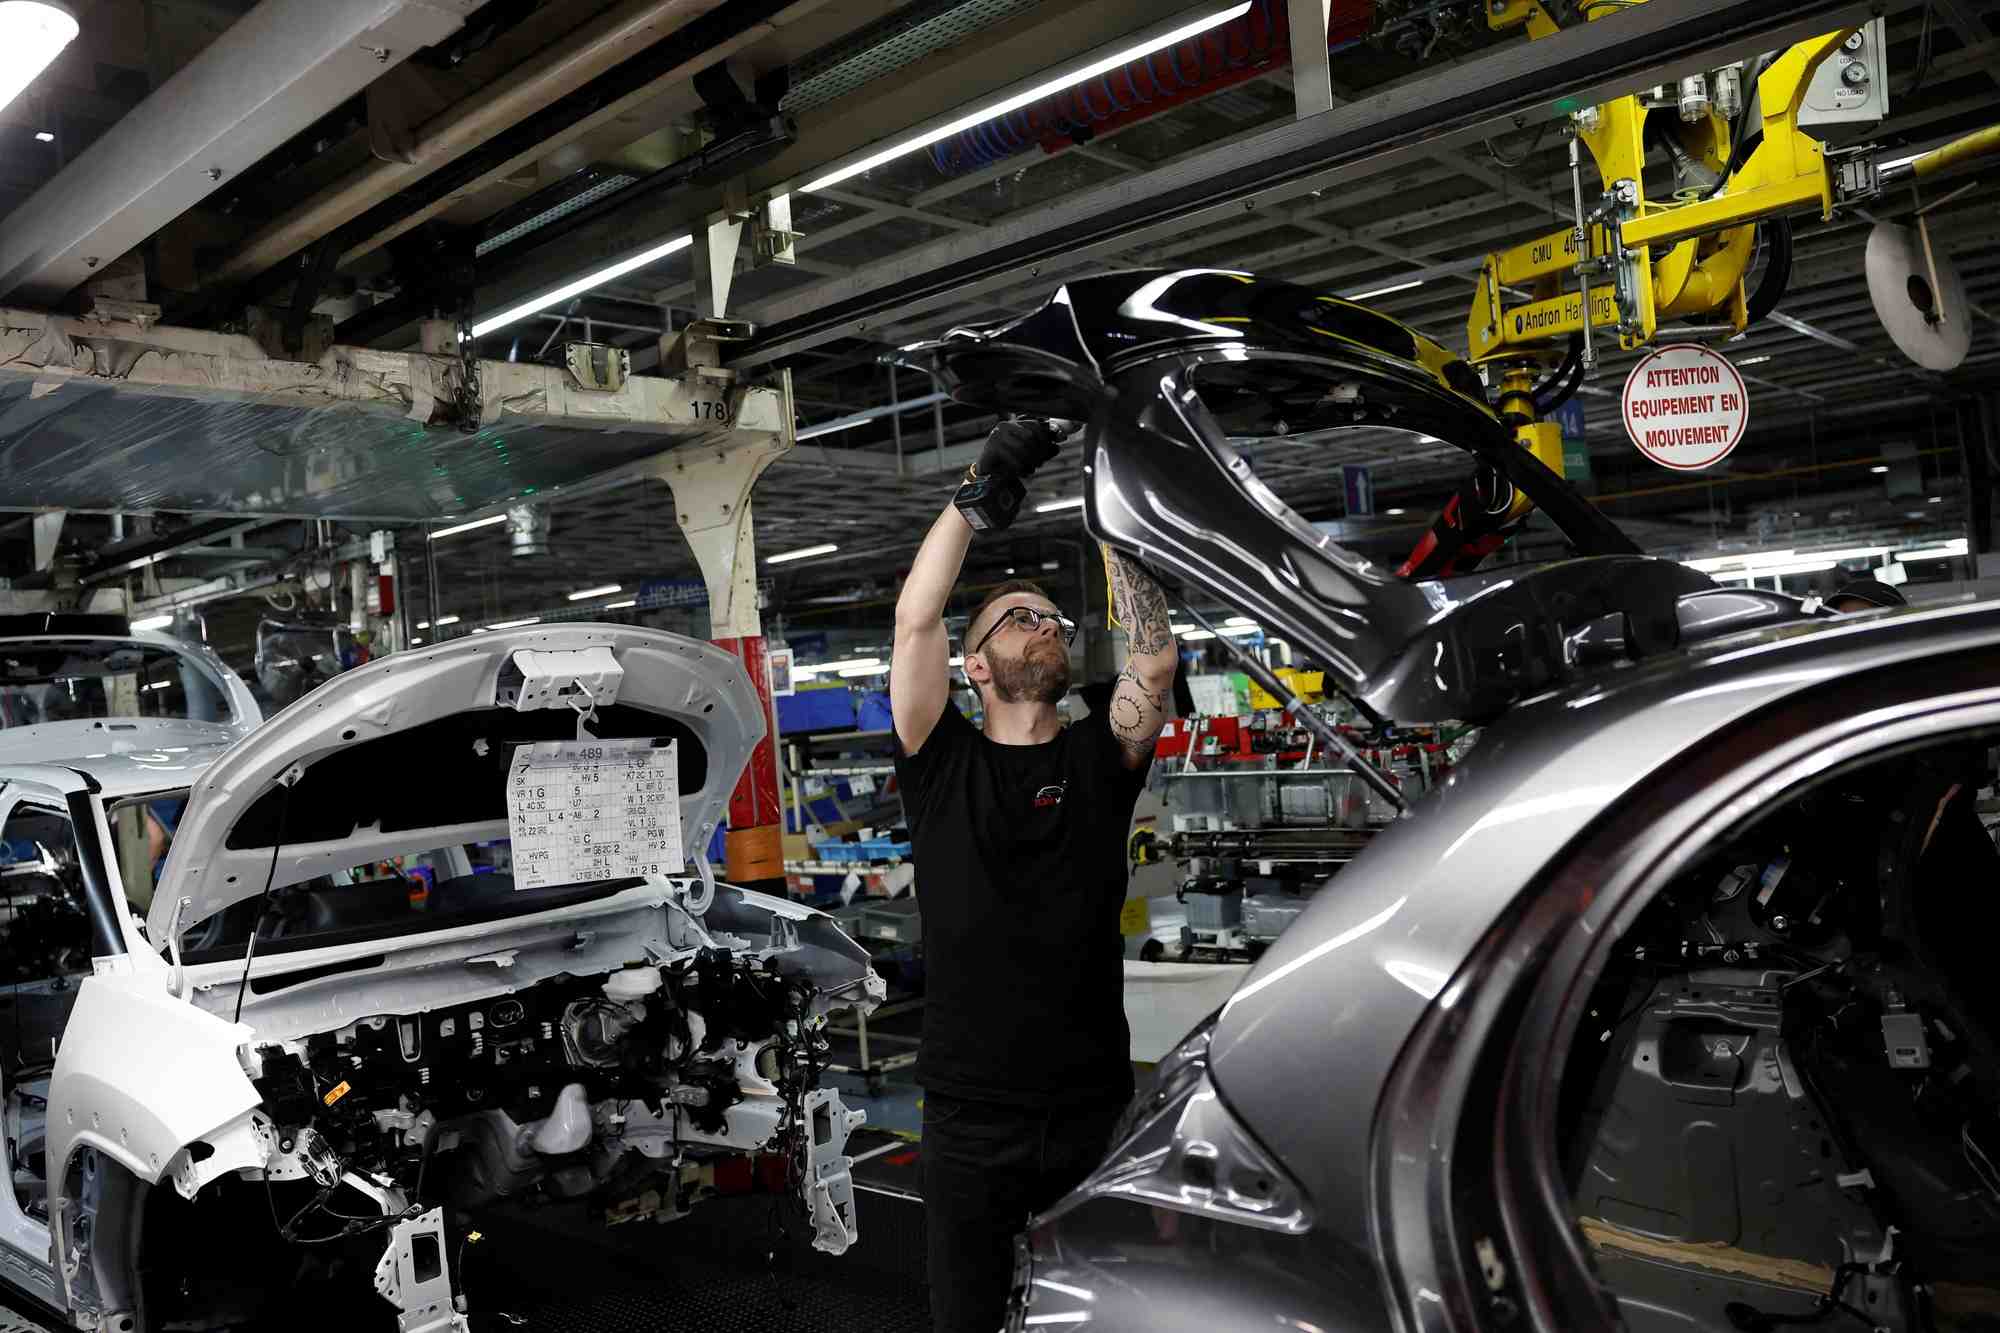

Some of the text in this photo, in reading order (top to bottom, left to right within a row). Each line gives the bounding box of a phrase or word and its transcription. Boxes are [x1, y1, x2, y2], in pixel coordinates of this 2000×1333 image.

[1532, 243, 1552, 264] CMU
[1525, 296, 1610, 330] Andron Hanling
[1647, 366, 1720, 388] ATTENTION
[691, 400, 725, 420] 178
[1631, 393, 1739, 419] EQUIPEMENT EN
[1645, 425, 1729, 448] MOUVEMENT
[580, 747, 602, 760] 489
[519, 763, 530, 774] 7
[593, 773, 600, 782] 5
[529, 789, 533, 798] 1
[536, 787, 545, 798] G
[636, 783, 643, 792] L
[518, 802, 525, 812] L
[518, 812, 564, 824] N L 4
[593, 809, 600, 818] 2
[583, 833, 592, 844] C
[614, 844, 620, 854] 2
[660, 840, 666, 849] 2
[604, 855, 610, 866] L
[531, 863, 539, 874] L
[604, 869, 611, 879] 3
[641, 865, 648, 875] 2
[651, 864, 658, 874] B
